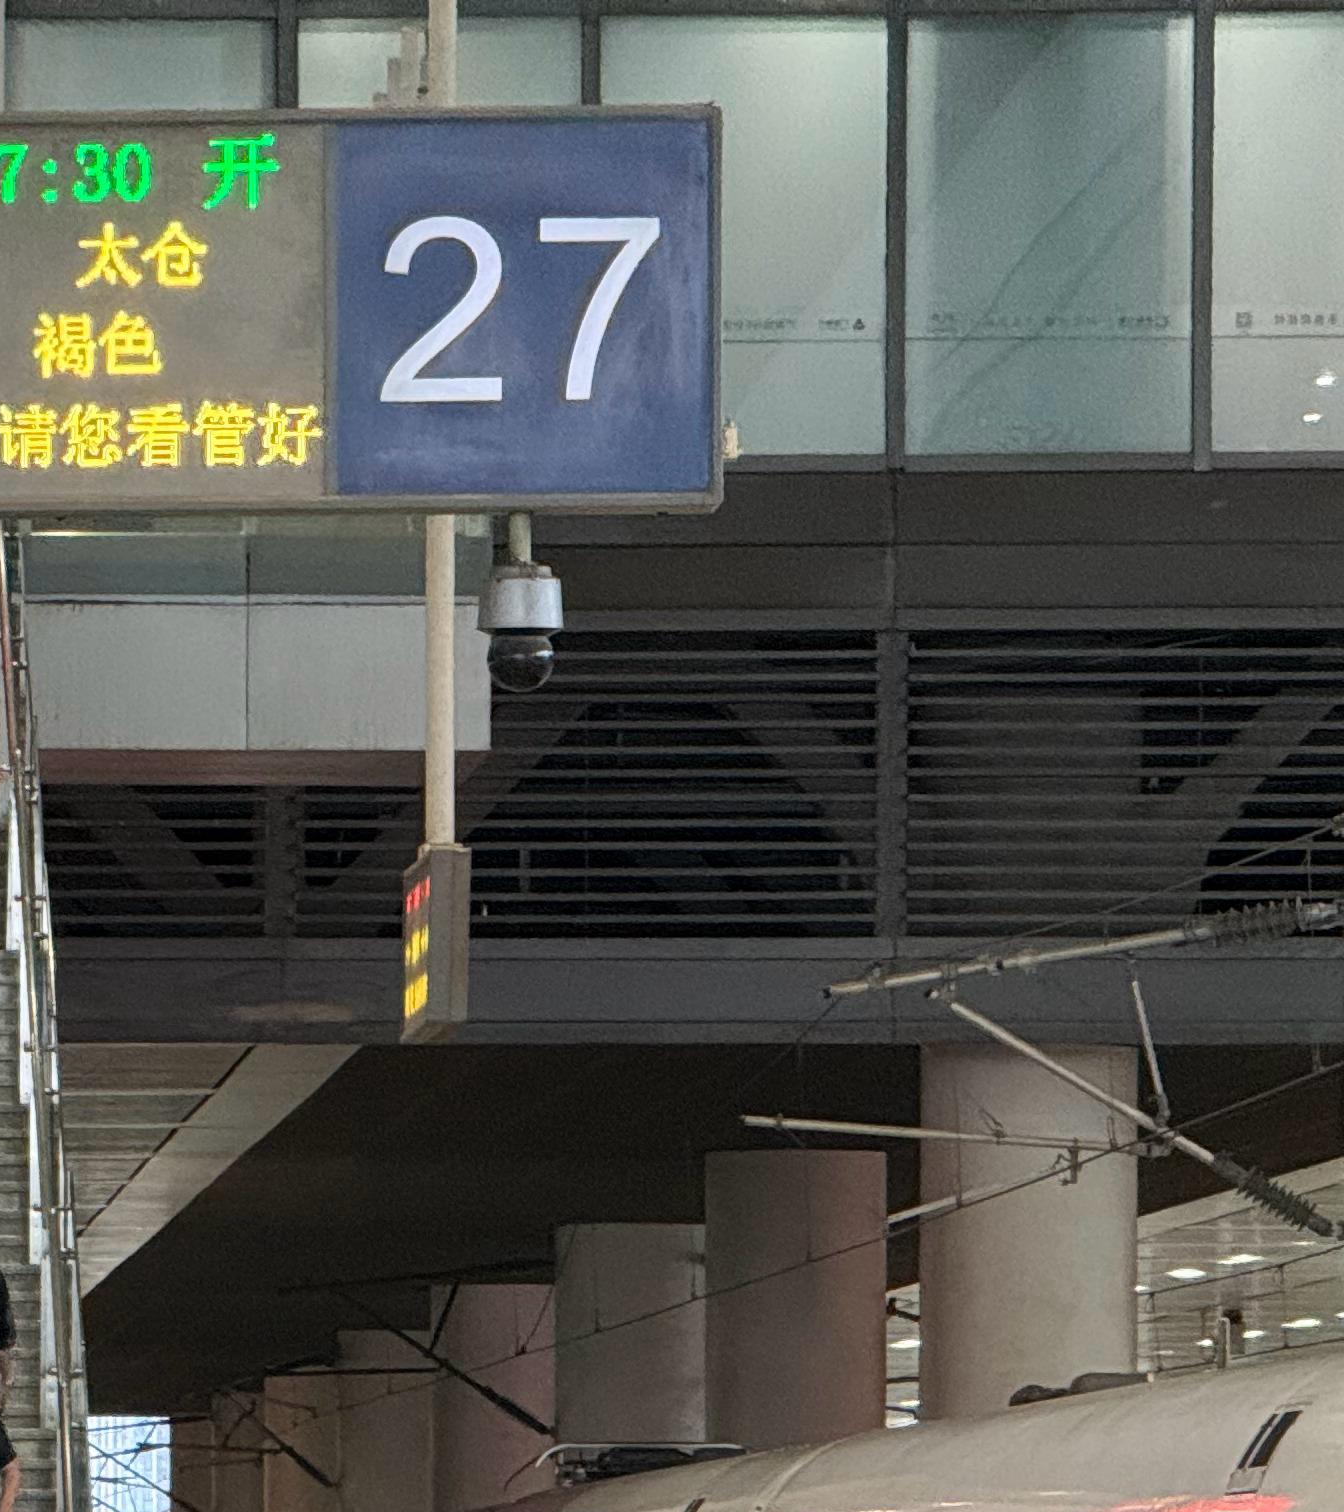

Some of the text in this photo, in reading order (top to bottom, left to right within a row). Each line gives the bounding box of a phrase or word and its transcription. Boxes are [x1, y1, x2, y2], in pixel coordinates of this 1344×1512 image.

[202, 133, 280, 209] 开
[78, 223, 205, 289] 太仓
[380, 215, 661, 402] 27
[32, 312, 161, 378] 褐色
